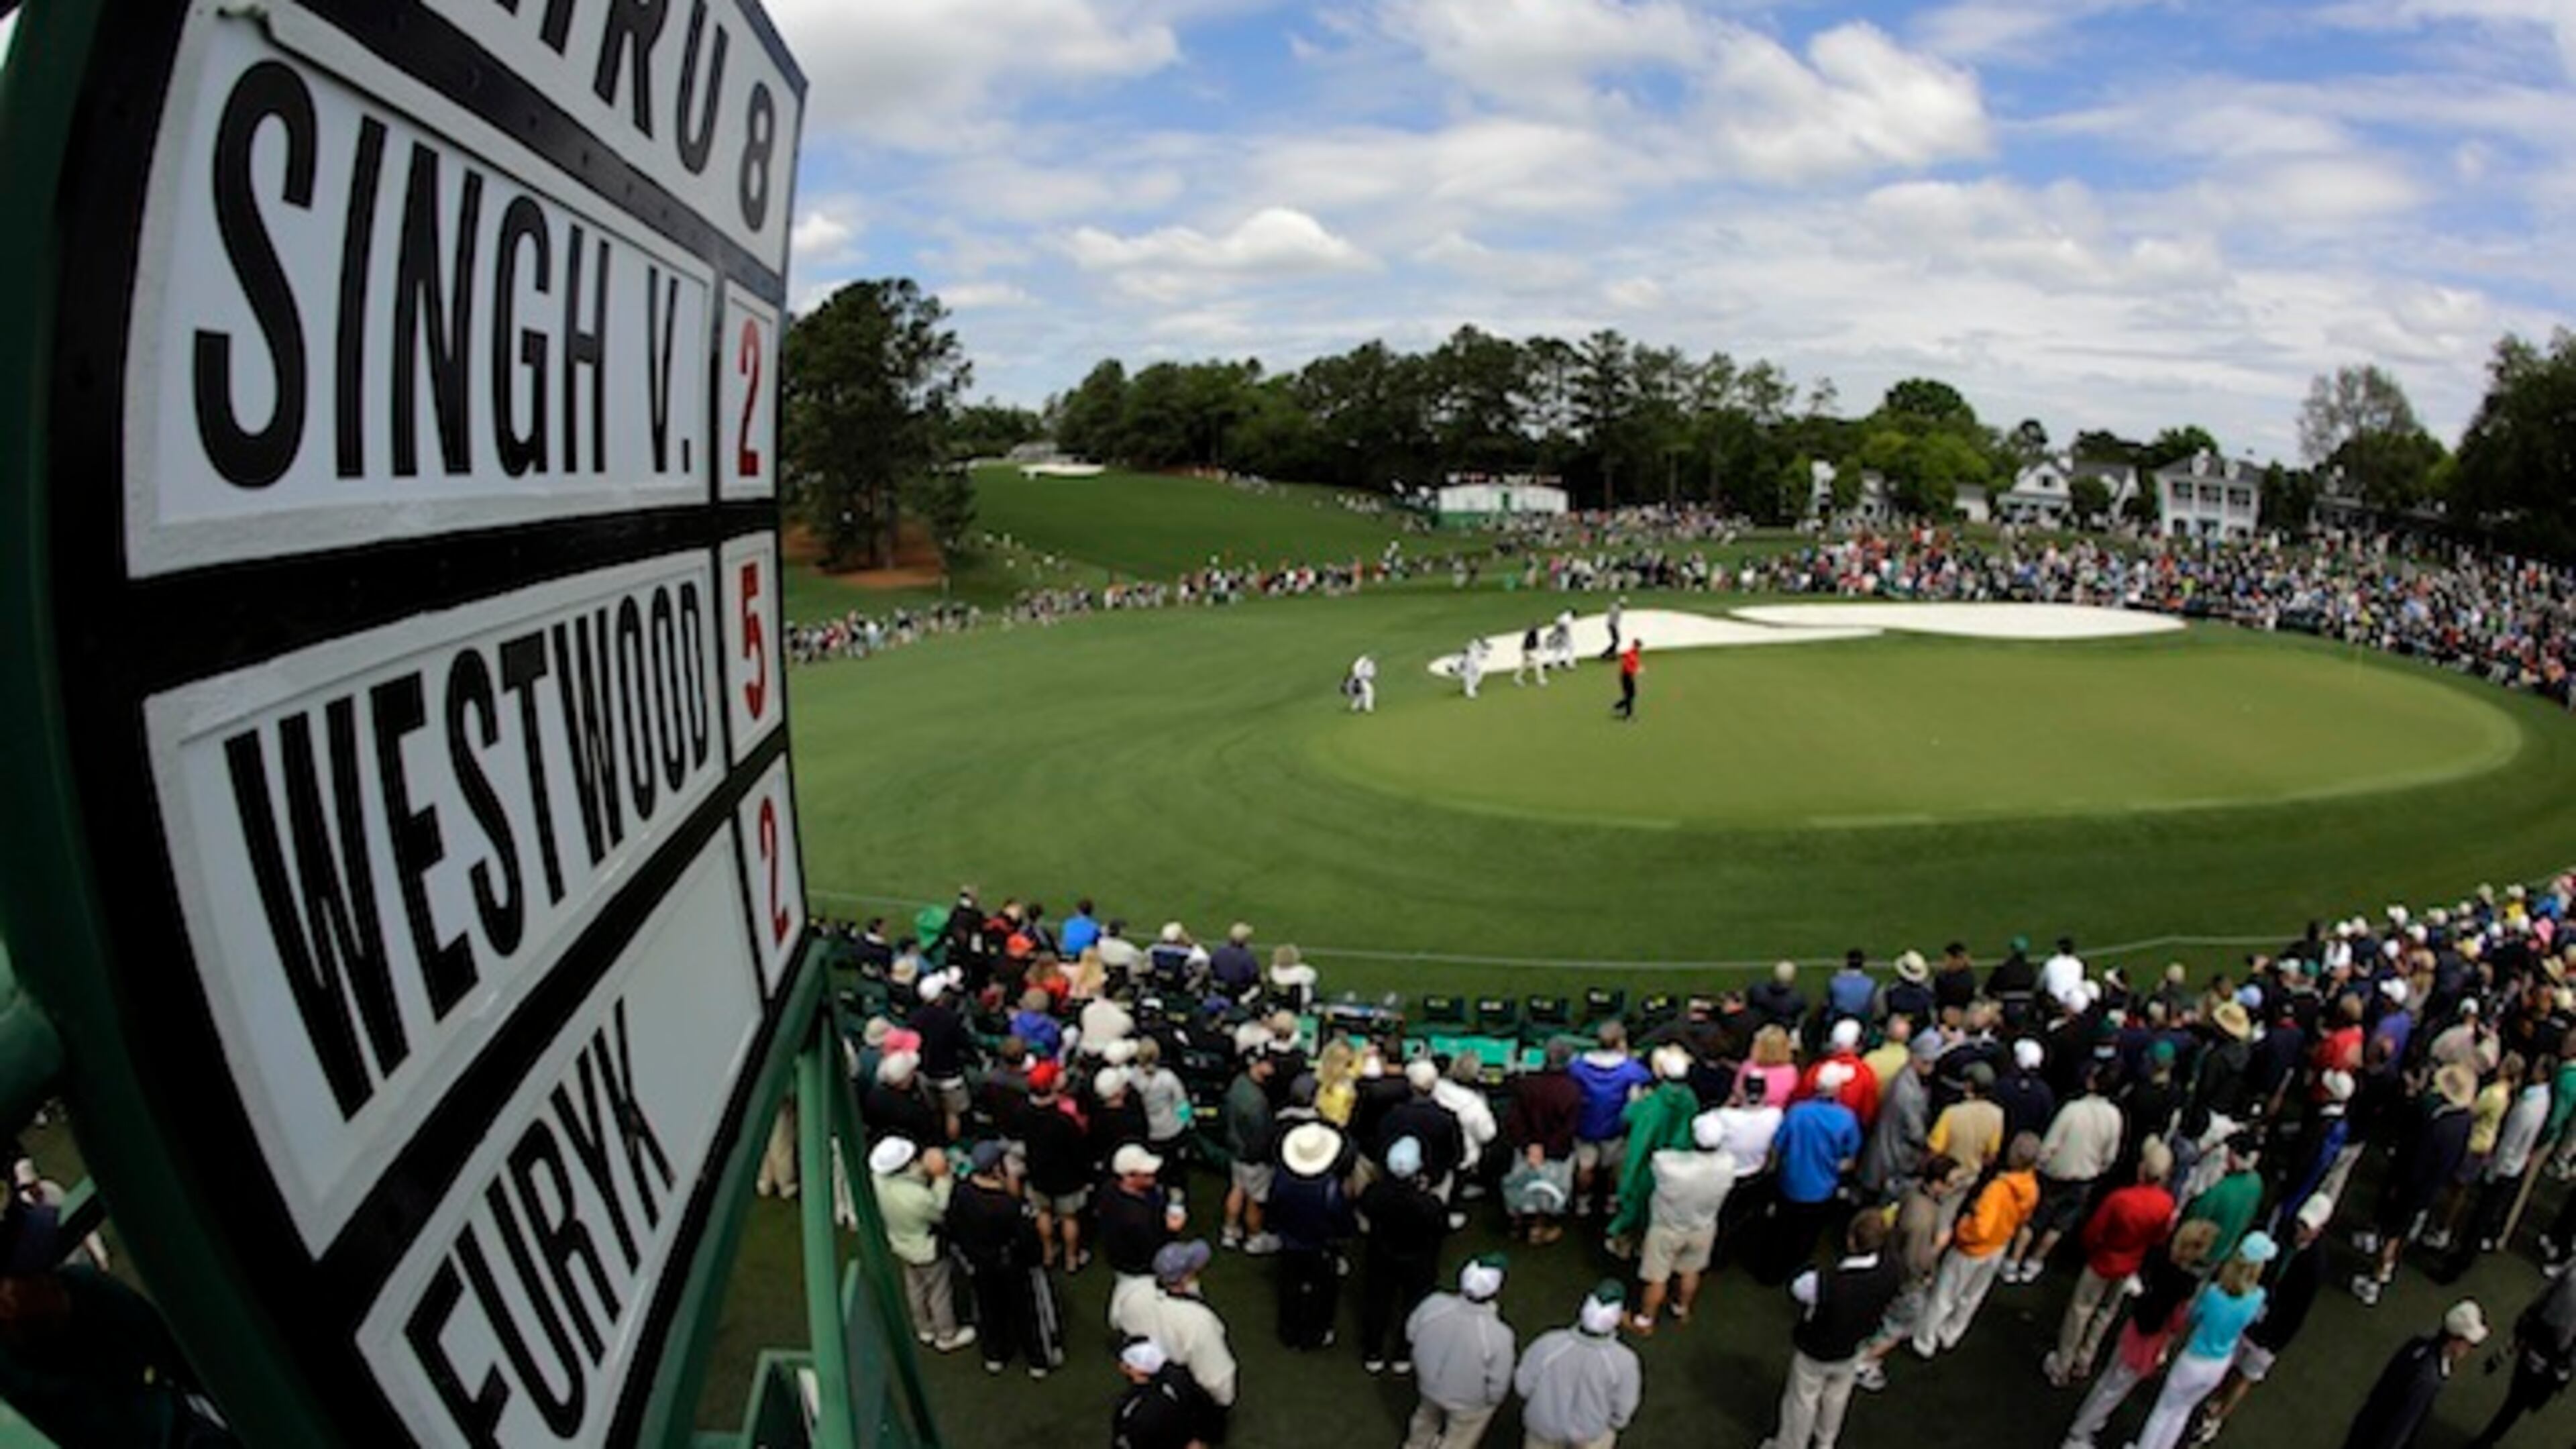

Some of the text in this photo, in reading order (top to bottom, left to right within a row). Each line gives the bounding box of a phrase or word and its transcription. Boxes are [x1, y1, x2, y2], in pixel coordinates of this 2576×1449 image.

[493, 0, 775, 233] RU 8
[193, 59, 690, 489] SINGH V.
[739, 318, 759, 477] 2
[739, 562, 765, 721] 5
[223, 581, 710, 1123] WESTWOOD
[758, 796, 789, 949] 2
[404, 996, 676, 1448] FURYK
